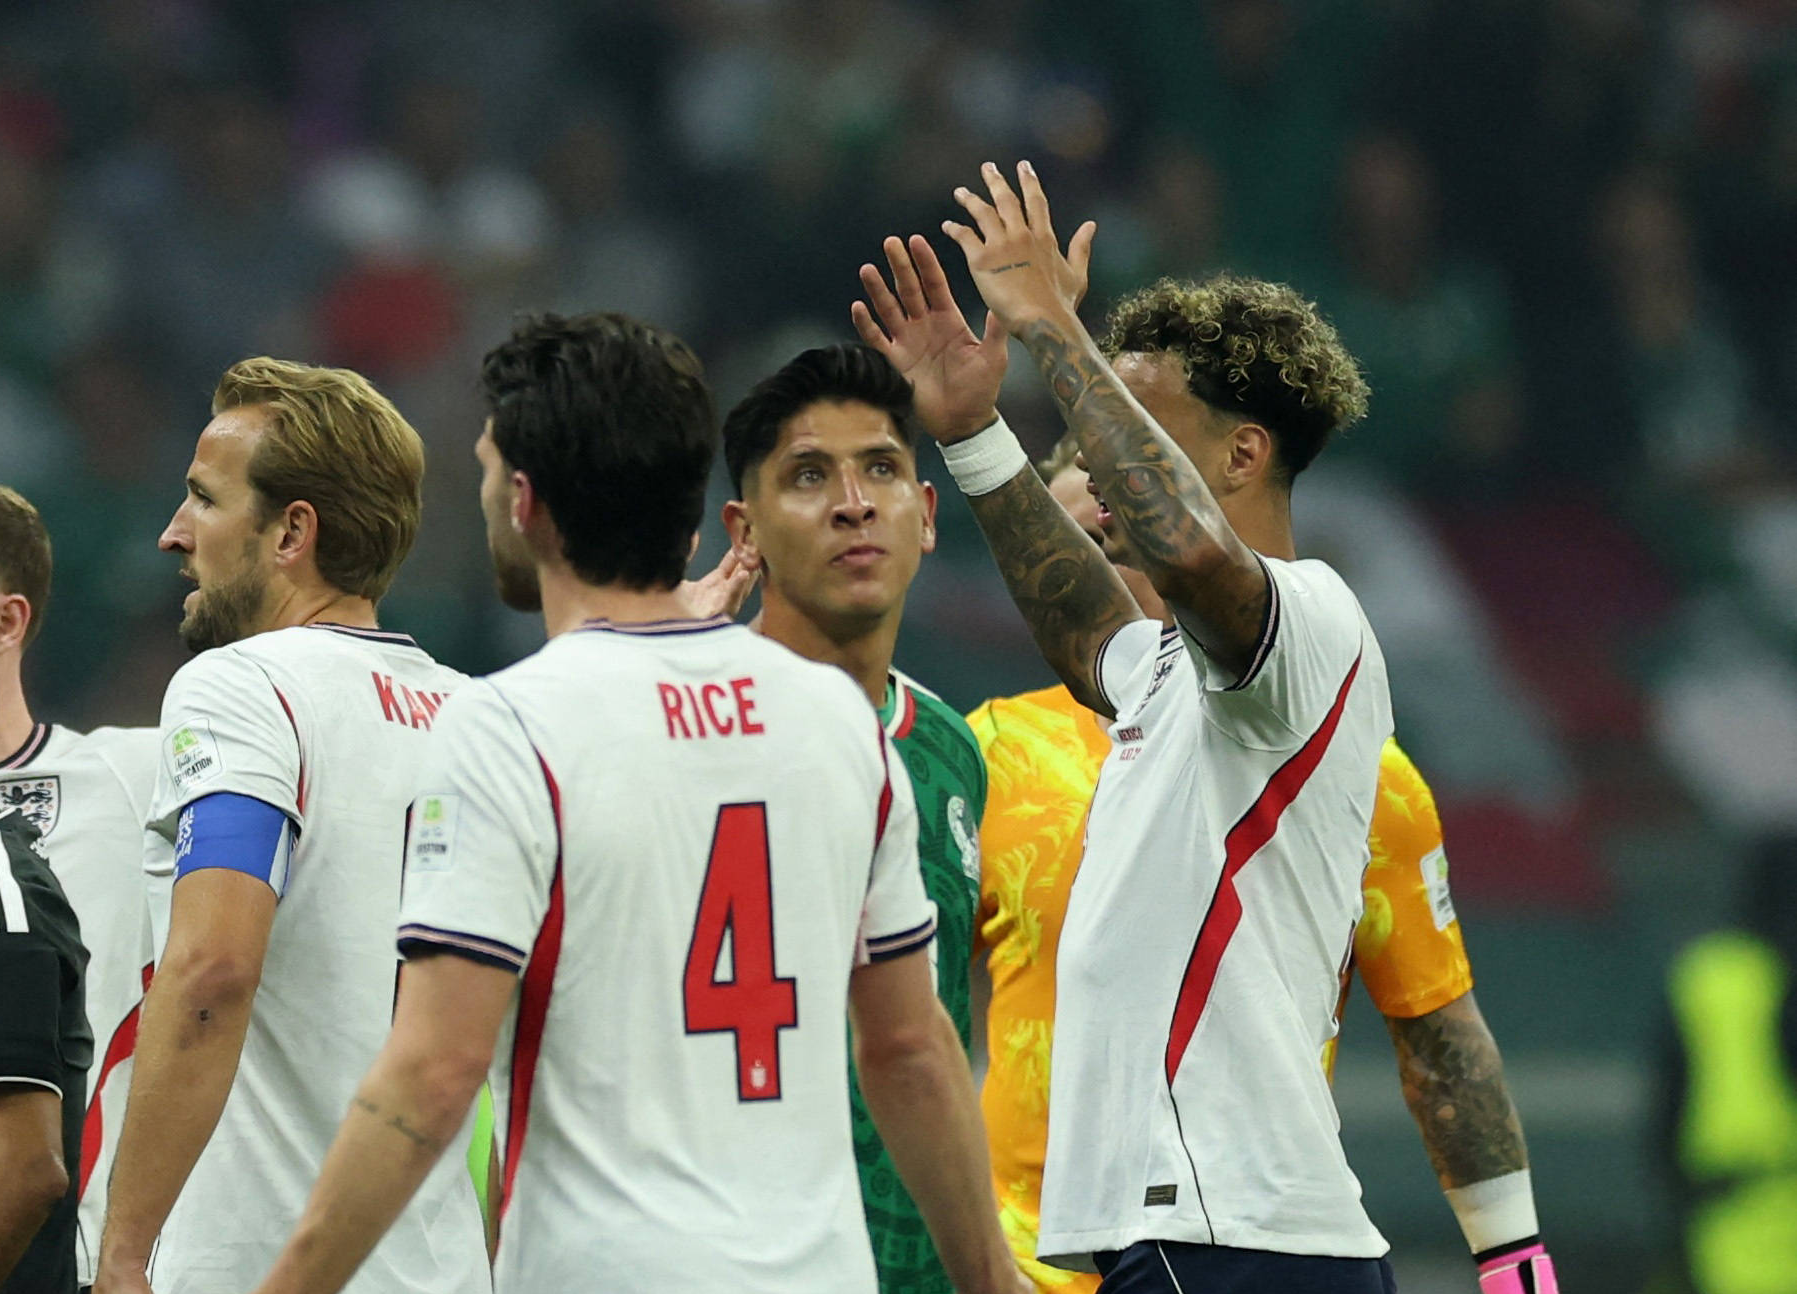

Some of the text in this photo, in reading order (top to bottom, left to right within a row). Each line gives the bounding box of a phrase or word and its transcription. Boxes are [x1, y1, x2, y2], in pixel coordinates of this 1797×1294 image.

[371, 671, 450, 732] KAN
[657, 677, 765, 739] RICE
[683, 800, 798, 1103] 4
